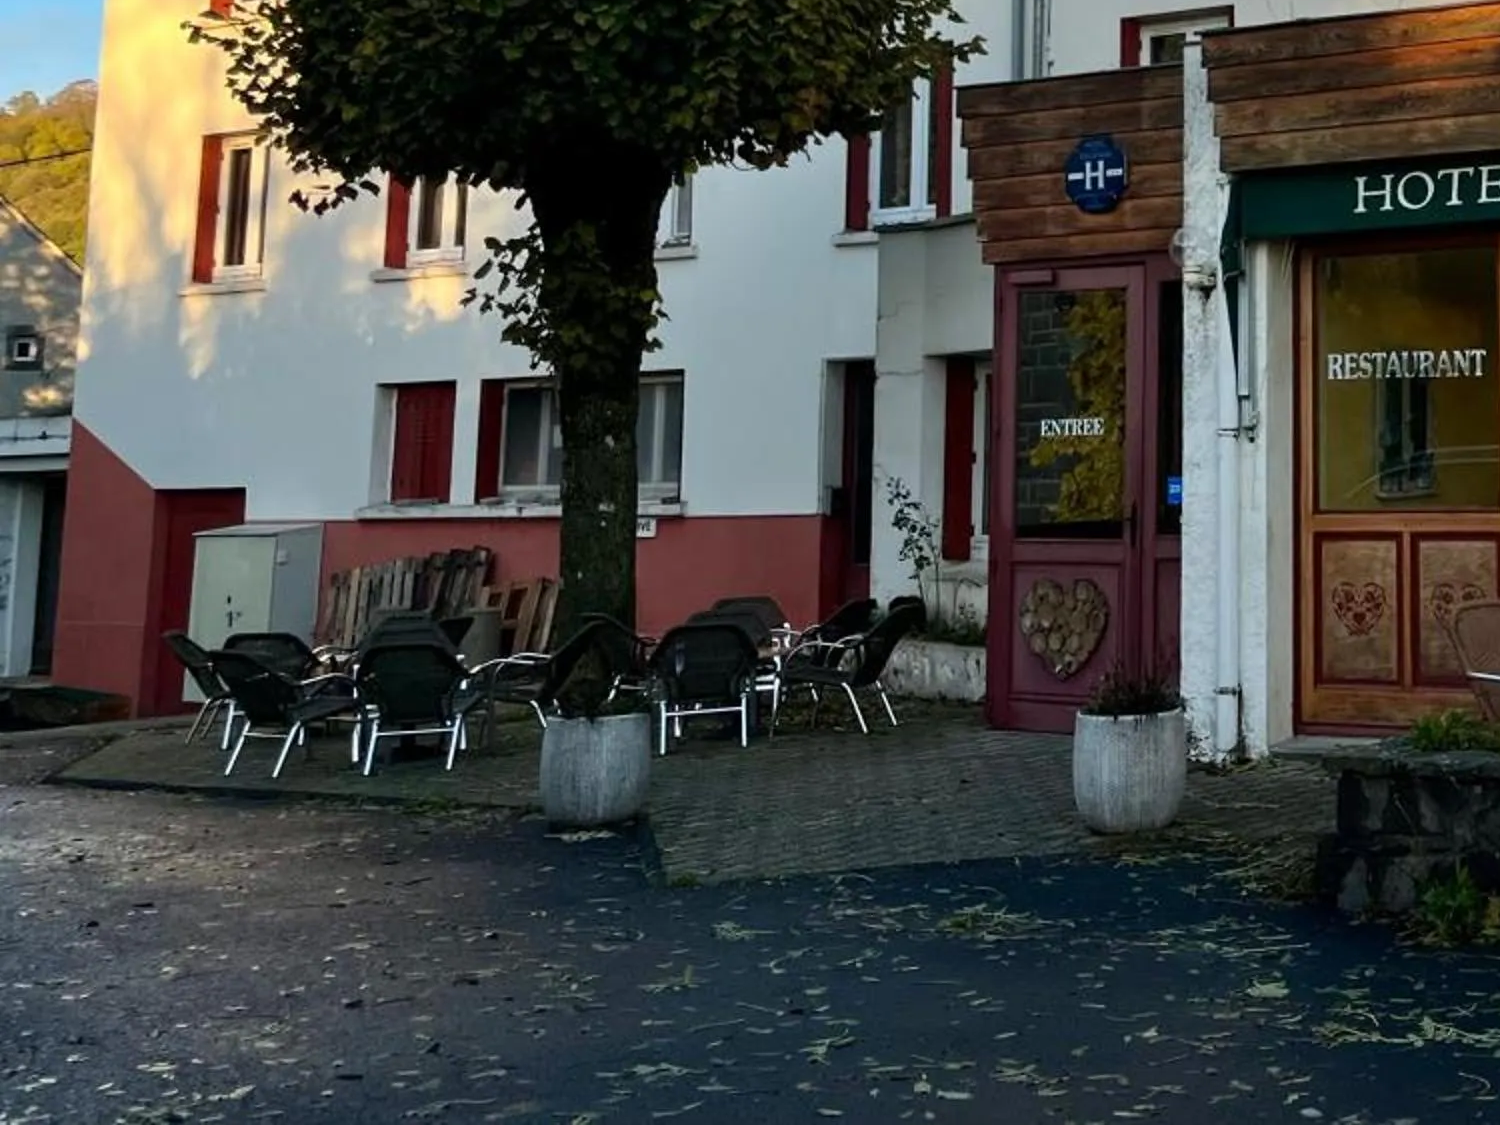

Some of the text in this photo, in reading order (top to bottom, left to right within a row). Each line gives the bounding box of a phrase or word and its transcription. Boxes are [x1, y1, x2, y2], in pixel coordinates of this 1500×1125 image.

[1084, 160, 1105, 191] H
[1327, 349, 1487, 380] RESTAURANT
[1040, 417, 1105, 437] ENTREE
